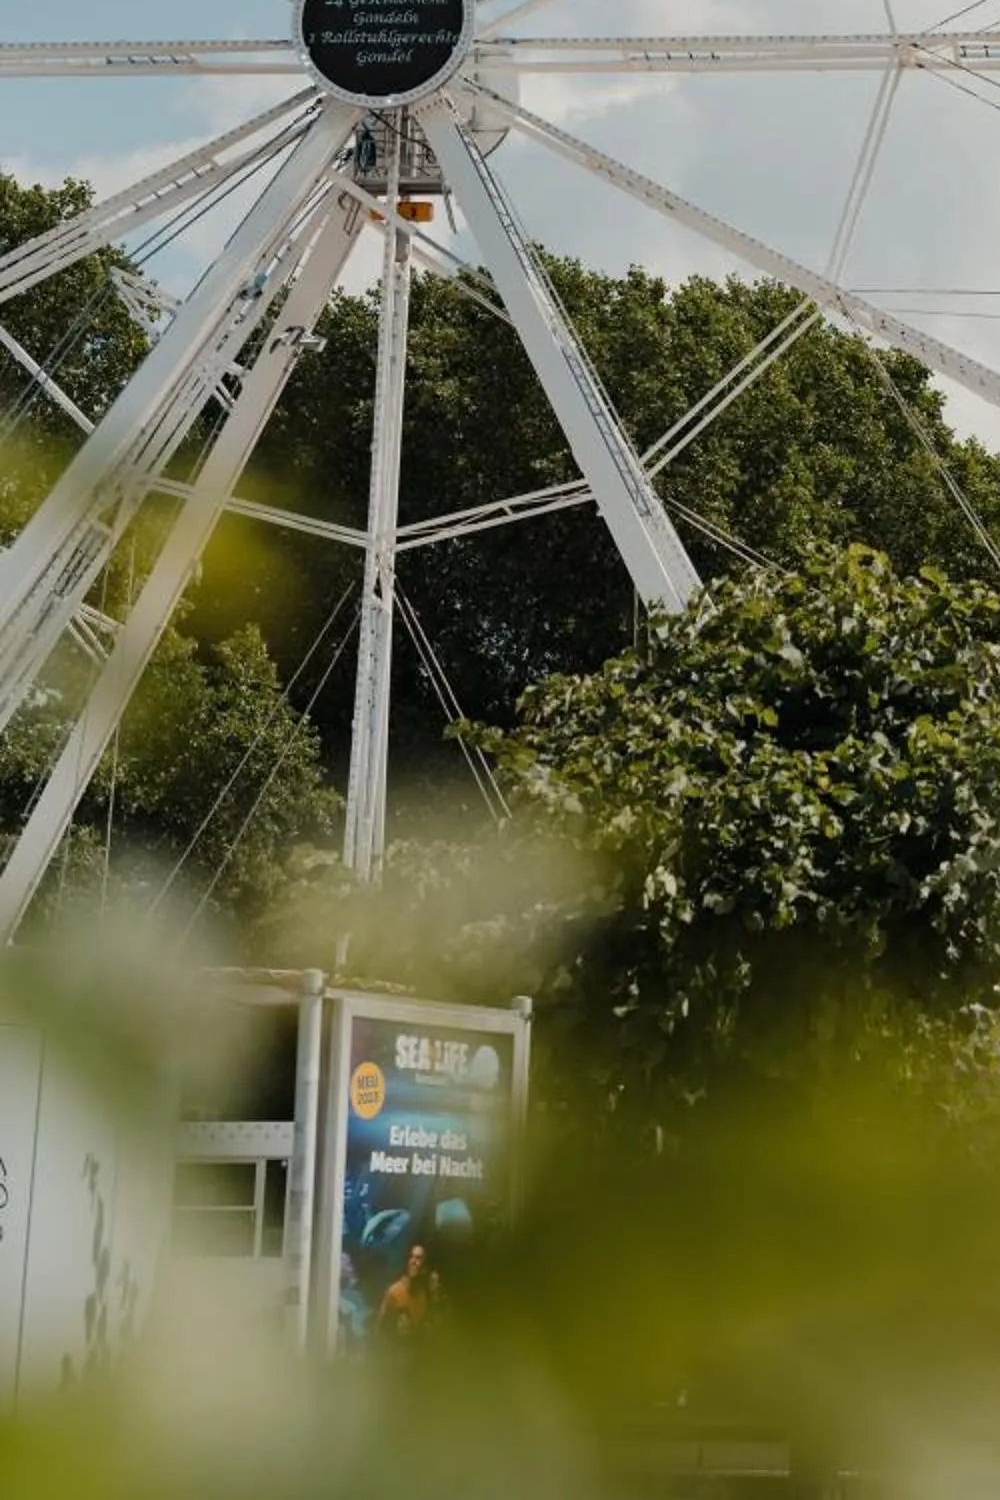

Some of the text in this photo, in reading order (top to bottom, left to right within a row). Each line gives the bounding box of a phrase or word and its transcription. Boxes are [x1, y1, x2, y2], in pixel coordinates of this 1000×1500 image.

[395, 1034, 431, 1070] SEA
[389, 1124, 468, 1151] Erlebe das
[369, 1151, 483, 1180] Meer bei Nacht
